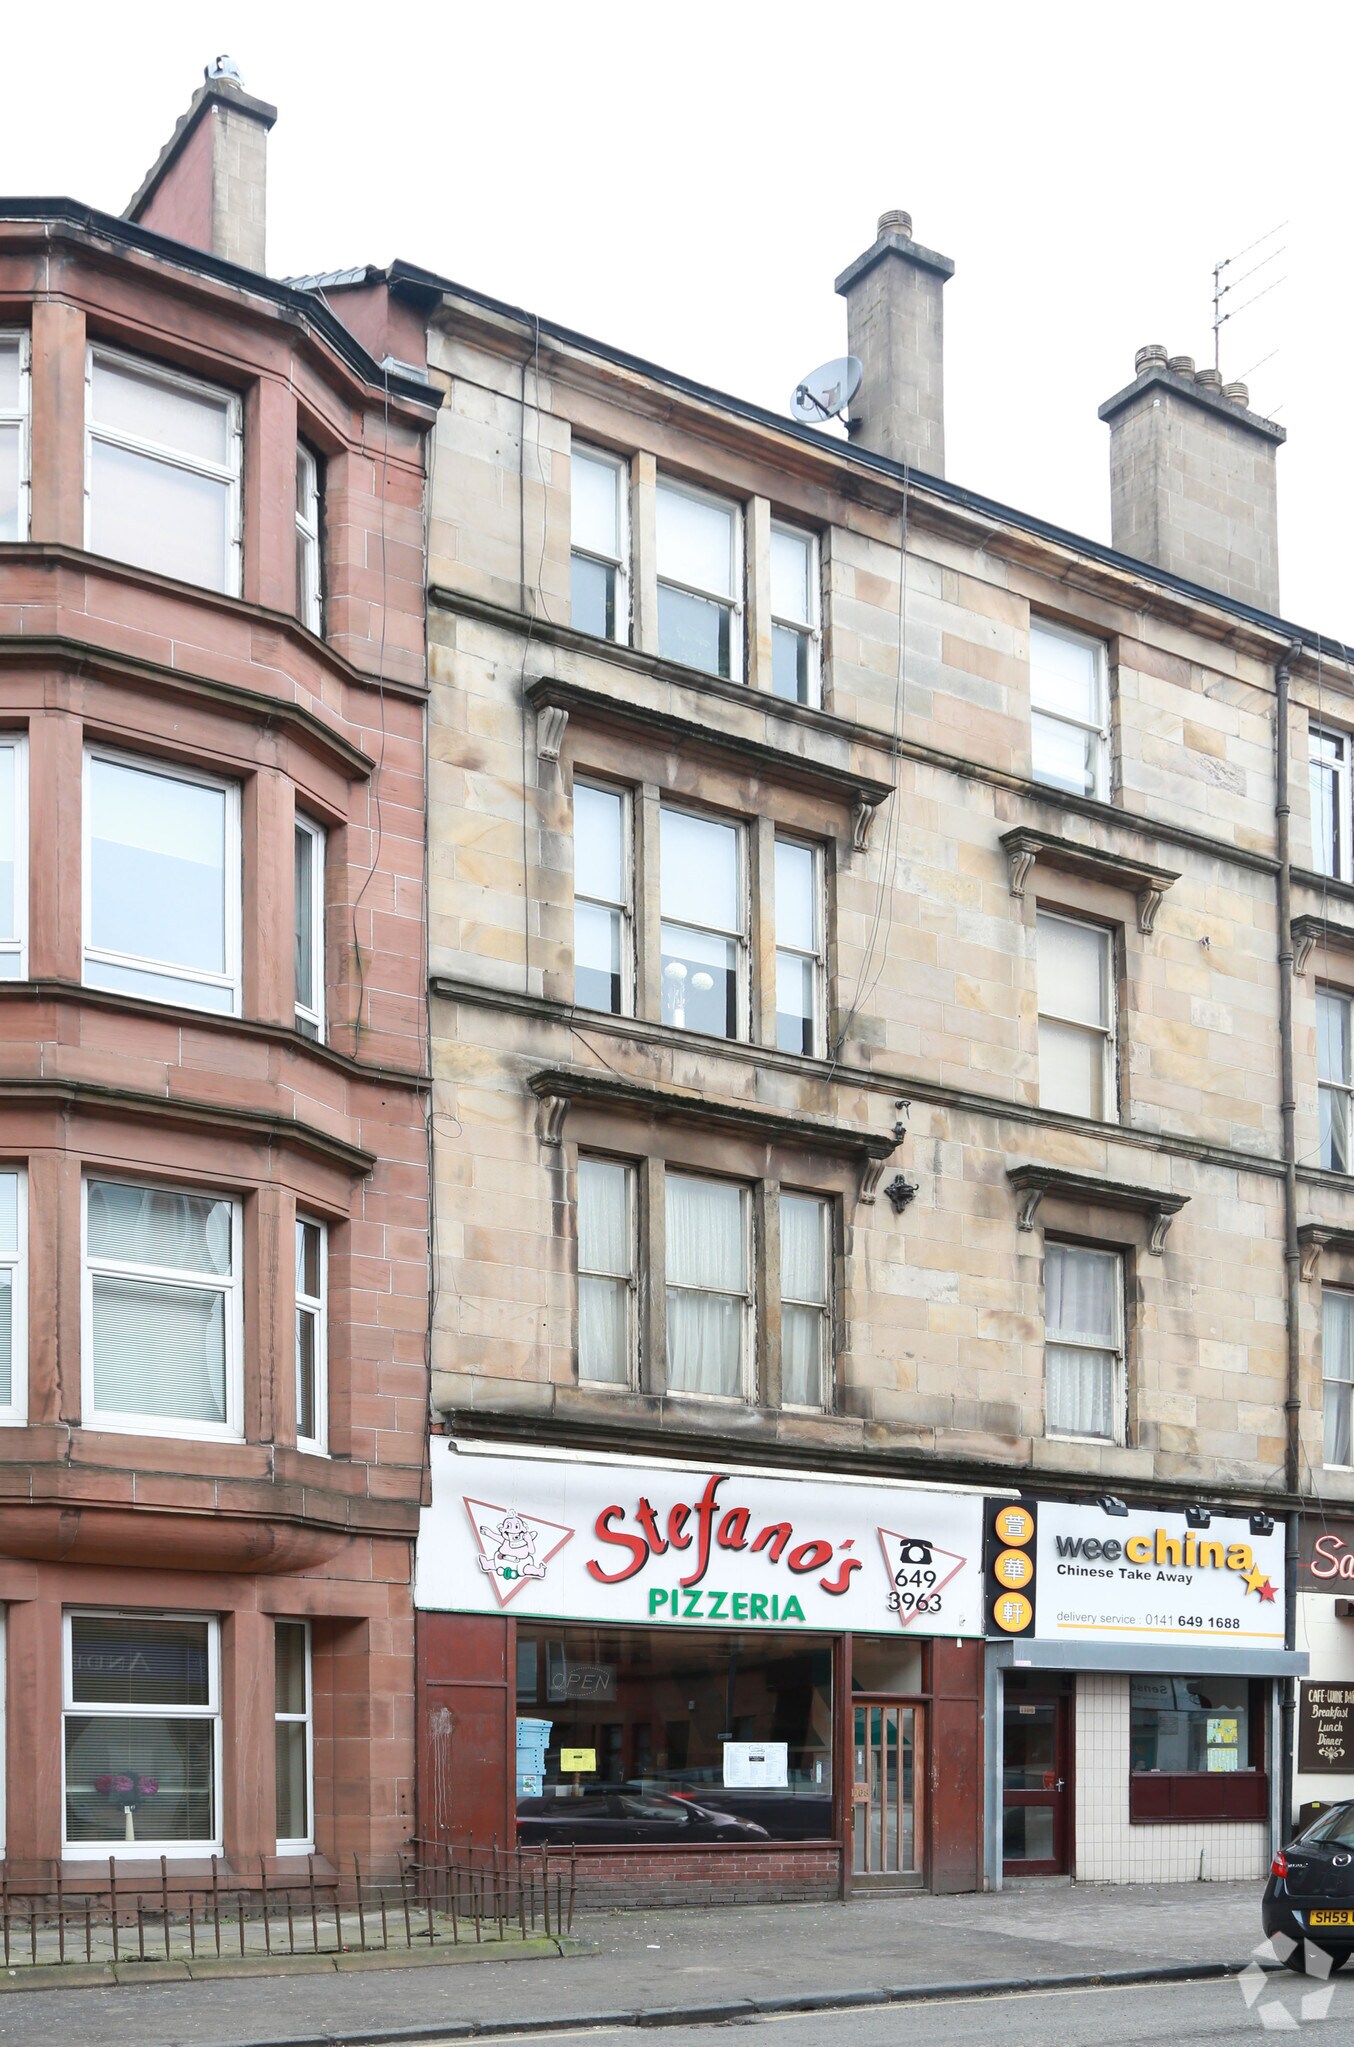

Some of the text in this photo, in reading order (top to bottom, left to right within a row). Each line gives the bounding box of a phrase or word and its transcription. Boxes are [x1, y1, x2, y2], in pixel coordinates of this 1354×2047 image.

[586, 1474, 863, 1596] Stefano's
[895, 1568, 937, 1589] 649
[1056, 1564, 1193, 1585] Chinese Take Away
[649, 1588, 806, 1622] PIZZERIA
[888, 1591, 942, 1612] 3963
[1056, 1611, 1097, 1625] delivery
[1100, 1613, 1136, 1625] service
[1145, 1613, 1174, 1626] 0141
[1178, 1615, 1203, 1628] 649
[1208, 1616, 1240, 1629] 1688
[553, 1673, 610, 1691] OPEN
[1311, 1704, 1348, 1719] Breakfast
[1318, 1719, 1343, 1732] Lunch
[1317, 1733, 1343, 1746] Dinner
[1315, 1911, 1348, 1923] SH59
